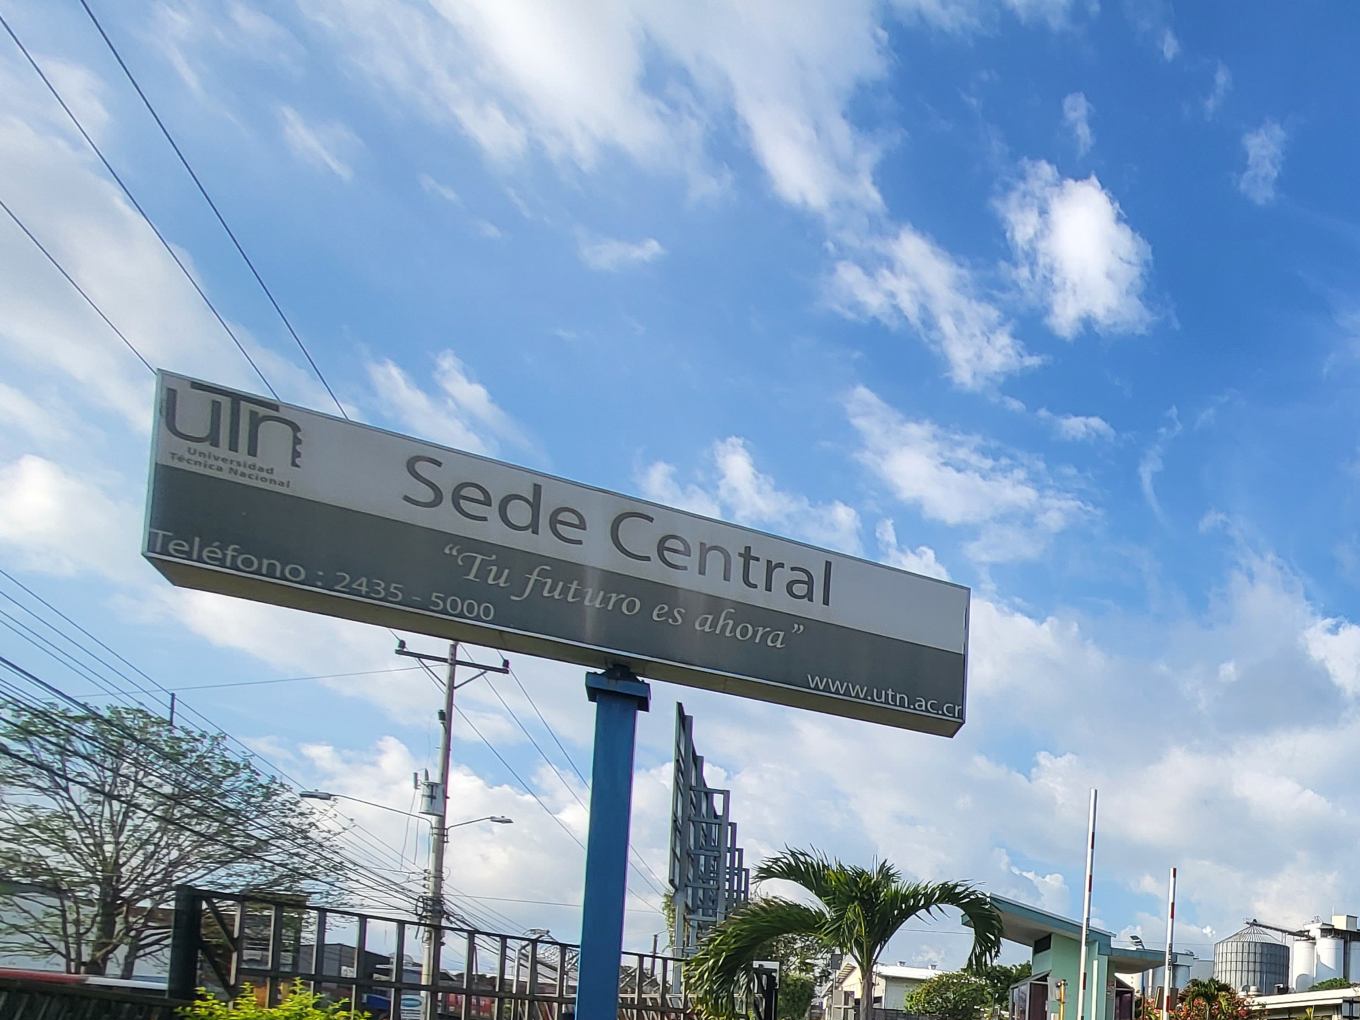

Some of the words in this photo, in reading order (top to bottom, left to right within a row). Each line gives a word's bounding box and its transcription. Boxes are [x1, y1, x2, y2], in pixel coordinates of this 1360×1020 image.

[168, 451, 224, 473] Técnica
[228, 466, 290, 489] Nacional
[186, 446, 275, 476] Universidad
[402, 454, 588, 547] Sede
[609, 511, 833, 606] Central
[149, 527, 306, 582] Teléfono
[334, 572, 405, 602] 2435
[429, 592, 496, 621] 5000
[510, 565, 641, 615] futuro
[652, 603, 686, 625] es
[807, 673, 963, 718] www.utn.ac.cr
